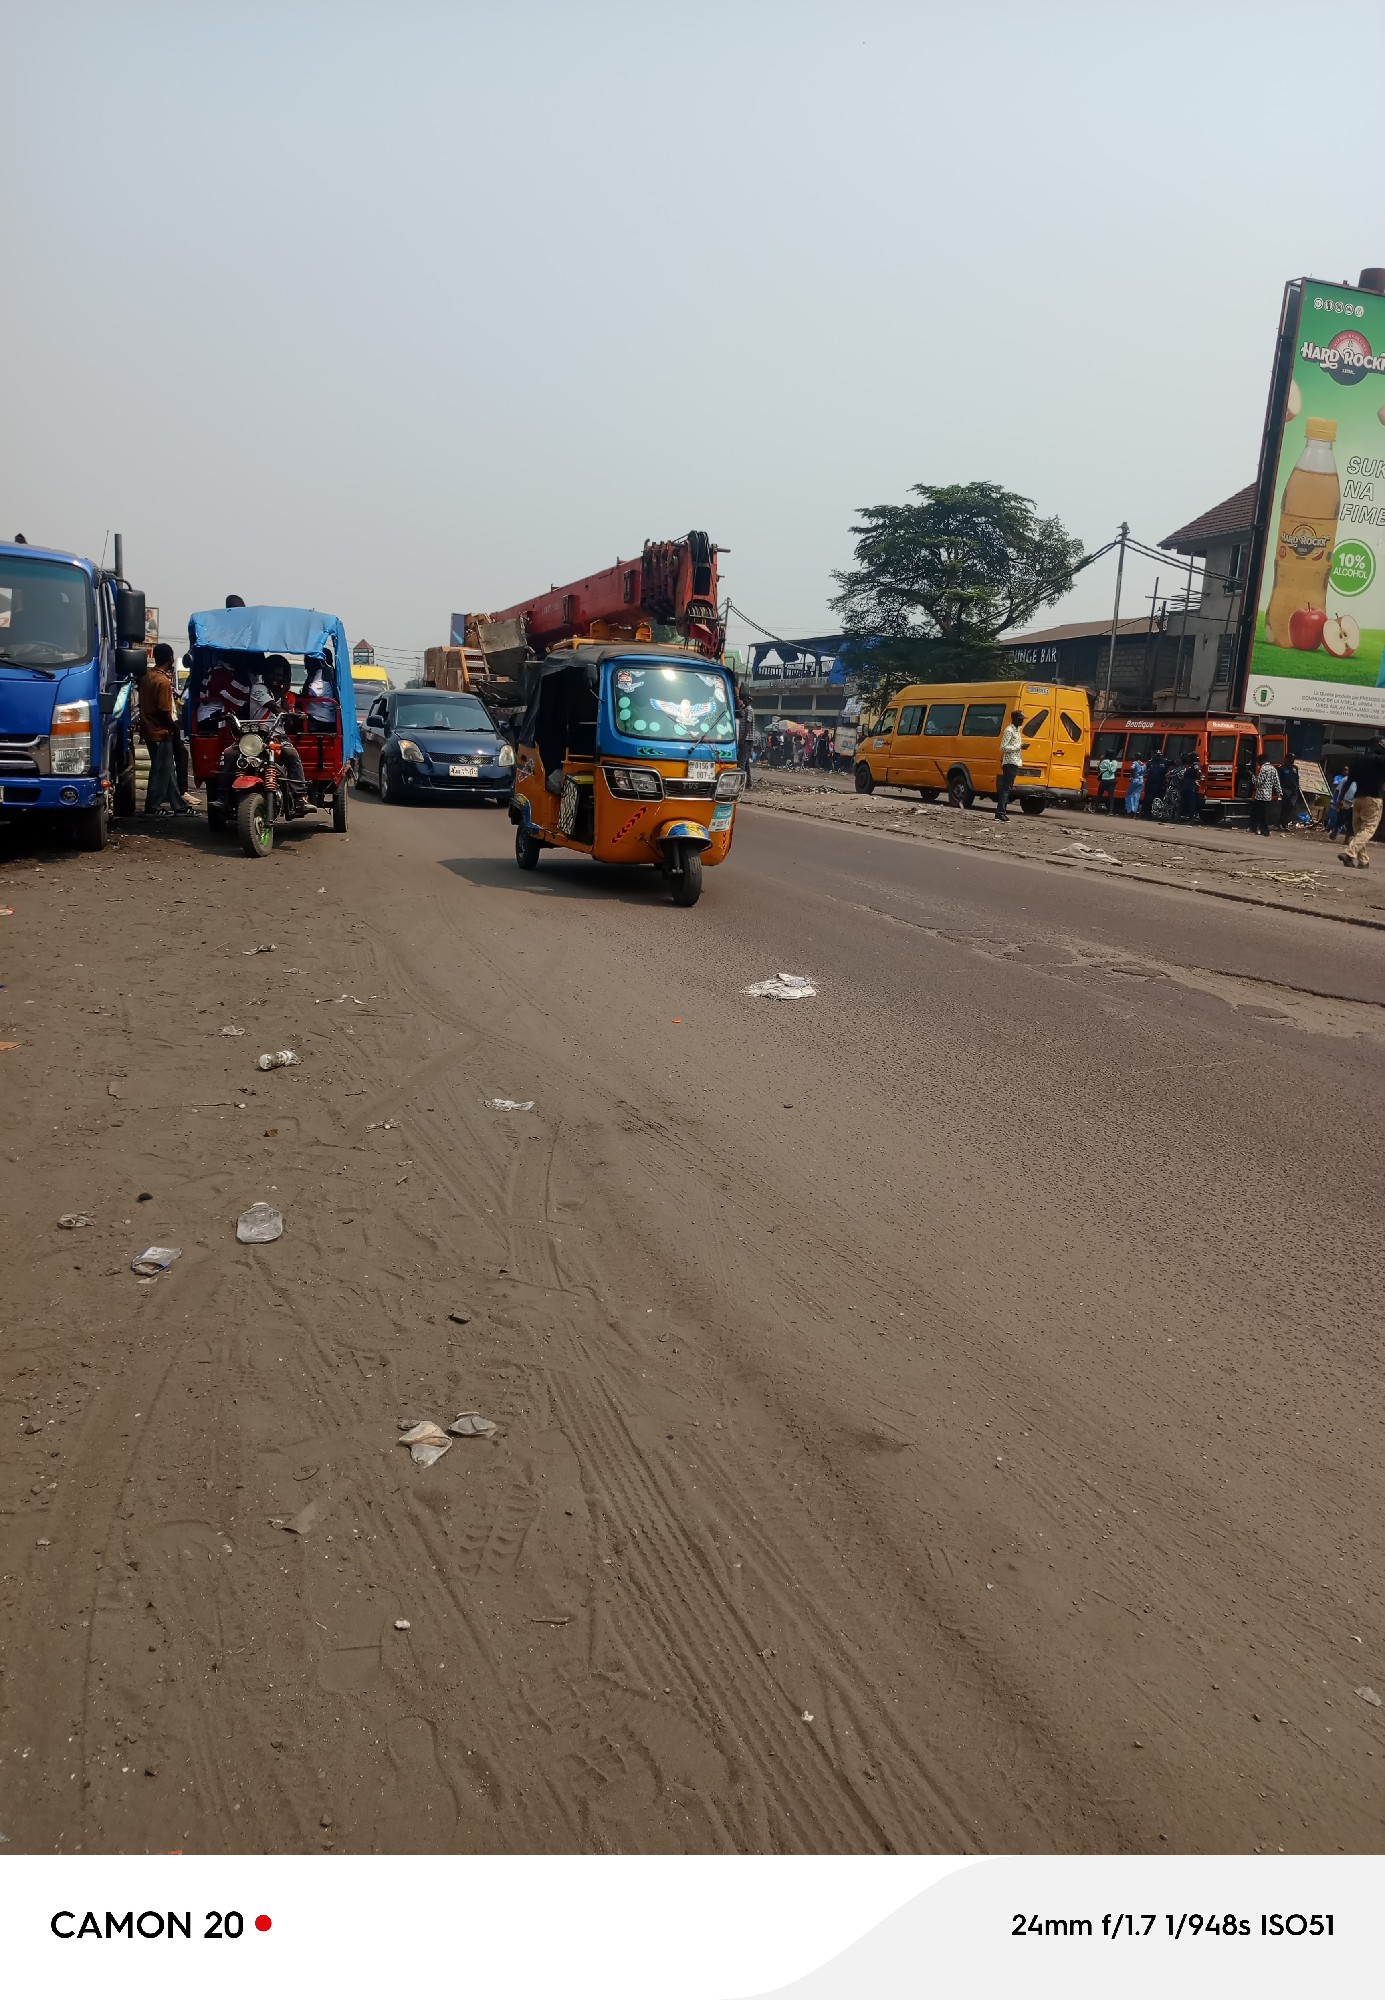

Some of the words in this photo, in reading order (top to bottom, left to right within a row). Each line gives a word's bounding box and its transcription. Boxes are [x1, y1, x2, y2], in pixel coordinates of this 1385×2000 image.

[1301, 342, 1340, 369] HARD
[1343, 480, 1374, 501] NA
[1339, 553, 1366, 569] 10%
[1333, 566, 1367, 580] ALCOHOL
[1040, 647, 1057, 664] BAR
[1125, 719, 1155, 730] Boutique
[1212, 721, 1235, 729] Boutique
[682, 782, 699, 790] TVS
